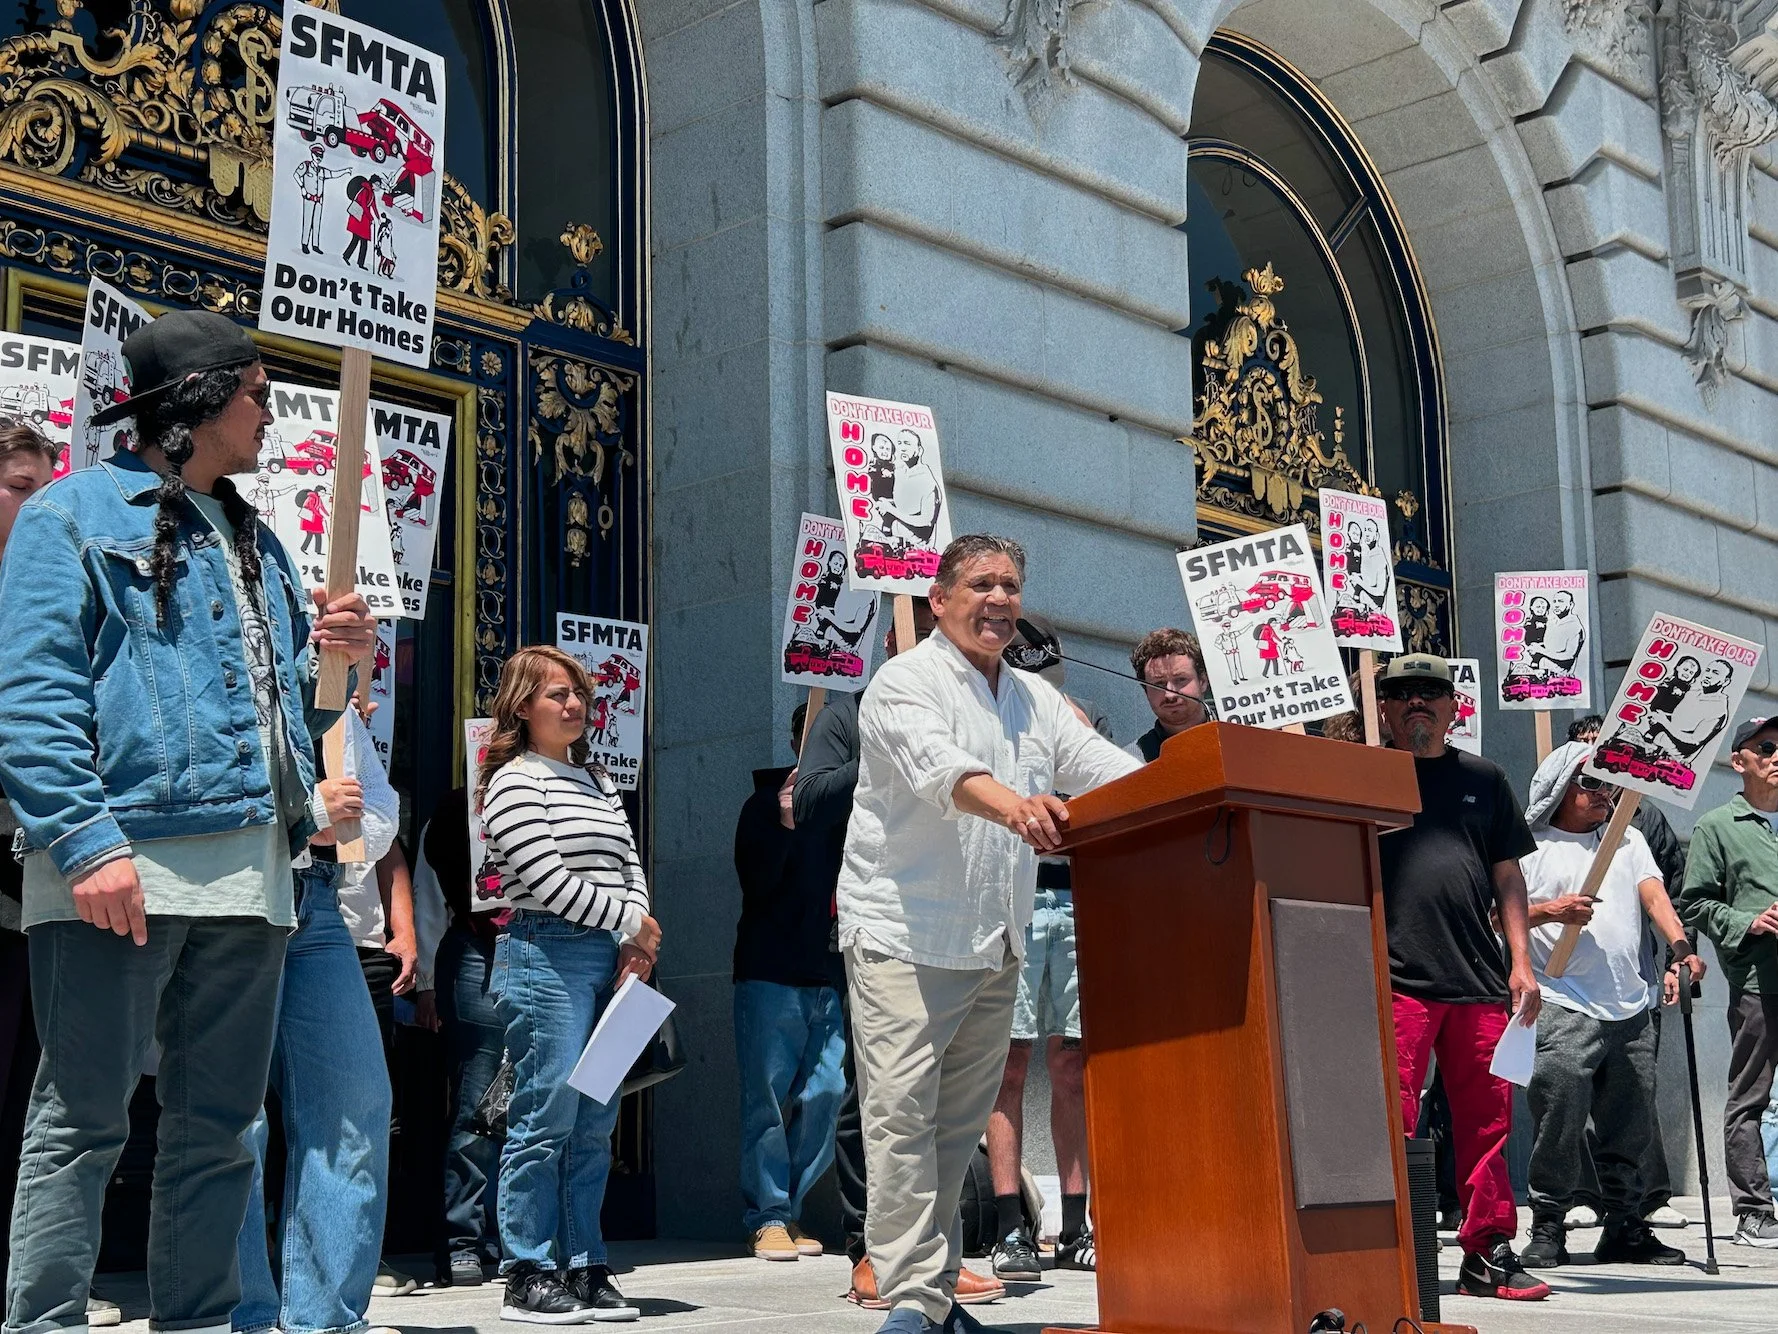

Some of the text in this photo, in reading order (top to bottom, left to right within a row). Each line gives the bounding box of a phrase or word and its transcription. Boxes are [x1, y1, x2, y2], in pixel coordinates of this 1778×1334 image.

[290, 14, 437, 105] SFMTA
[274, 262, 427, 324] Don't Take
[90, 289, 150, 342] SFM
[271, 295, 424, 354] Our Homes
[0, 341, 80, 379] SFM
[371, 407, 440, 449] MTA
[831, 399, 932, 429] DON'T TAKE OUR
[840, 419, 873, 520] HOME
[802, 519, 835, 539] DON'T
[1346, 499, 1369, 515] TAKE
[1369, 504, 1386, 519] OUR
[1186, 534, 1303, 583] SFMTA
[1328, 510, 1347, 592] HOME
[355, 566, 390, 587] ke
[397, 572, 423, 592] ke
[791, 537, 827, 624] HOME
[1531, 576, 1561, 589] TAKE
[1561, 576, 1585, 589] OUR
[561, 620, 643, 651] SFMTA
[1501, 590, 1526, 662] HOME
[1651, 618, 1757, 667] DON'T TAKE OUR
[1221, 675, 1340, 712] Don't Take
[1615, 637, 1678, 725] HOME
[1270, 693, 1345, 720] Homes
[603, 752, 638, 768] Take
[609, 772, 635, 784] mes
